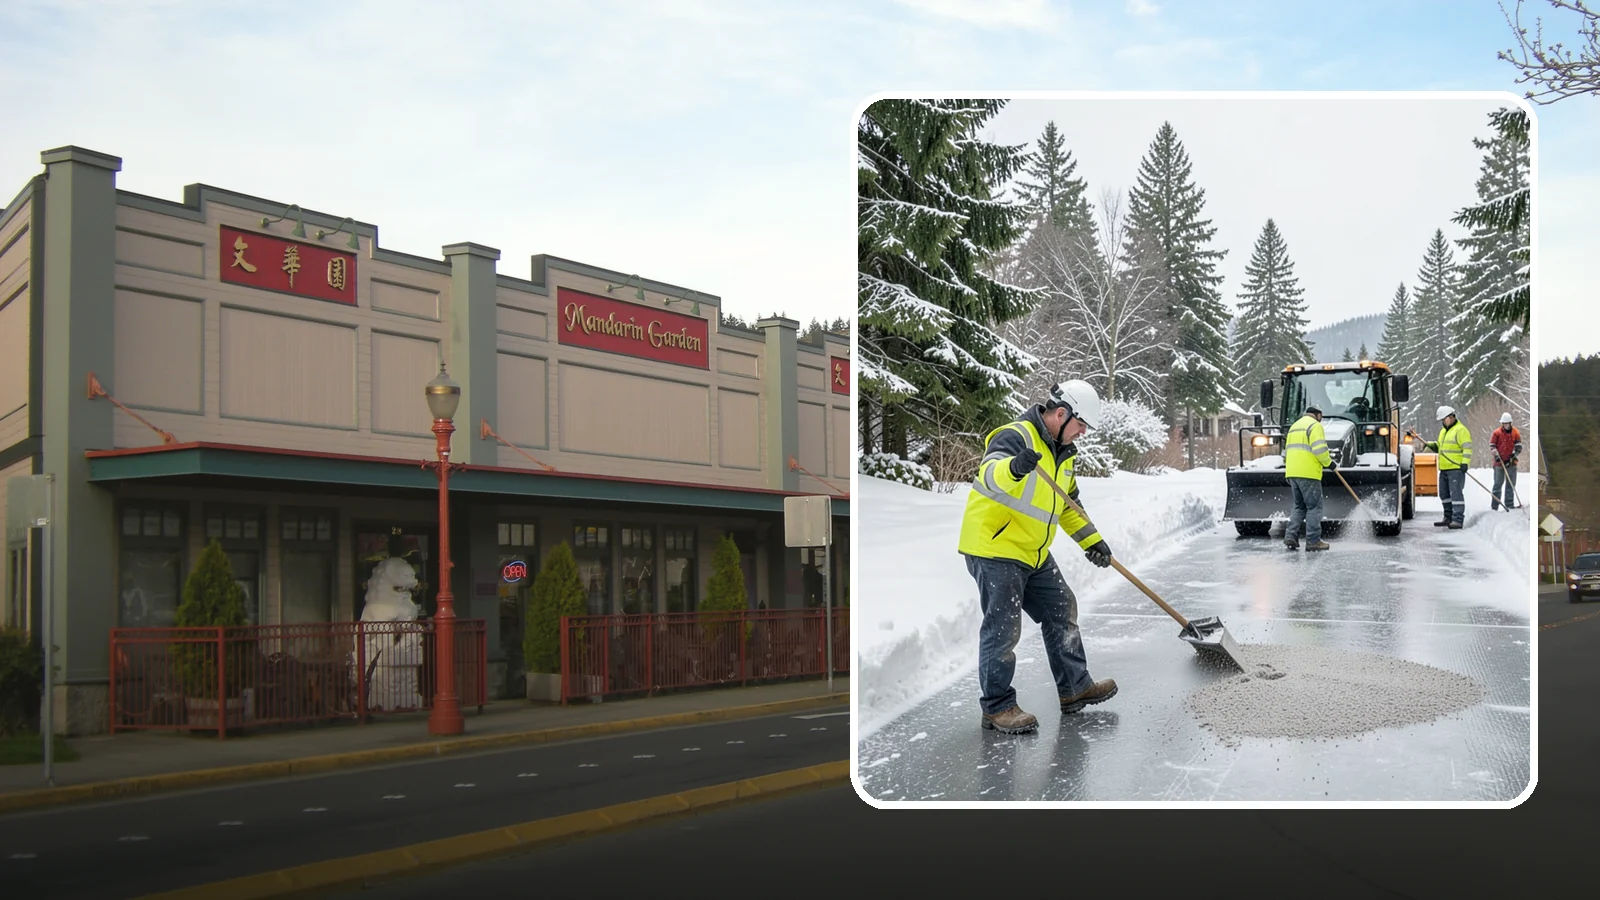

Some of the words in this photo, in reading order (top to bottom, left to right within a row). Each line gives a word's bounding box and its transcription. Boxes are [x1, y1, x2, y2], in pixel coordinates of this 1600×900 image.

[230, 235, 346, 291] 文華園
[564, 302, 644, 341] Mandarin
[648, 320, 702, 352] Garden
[503, 565, 527, 578] OPEN
